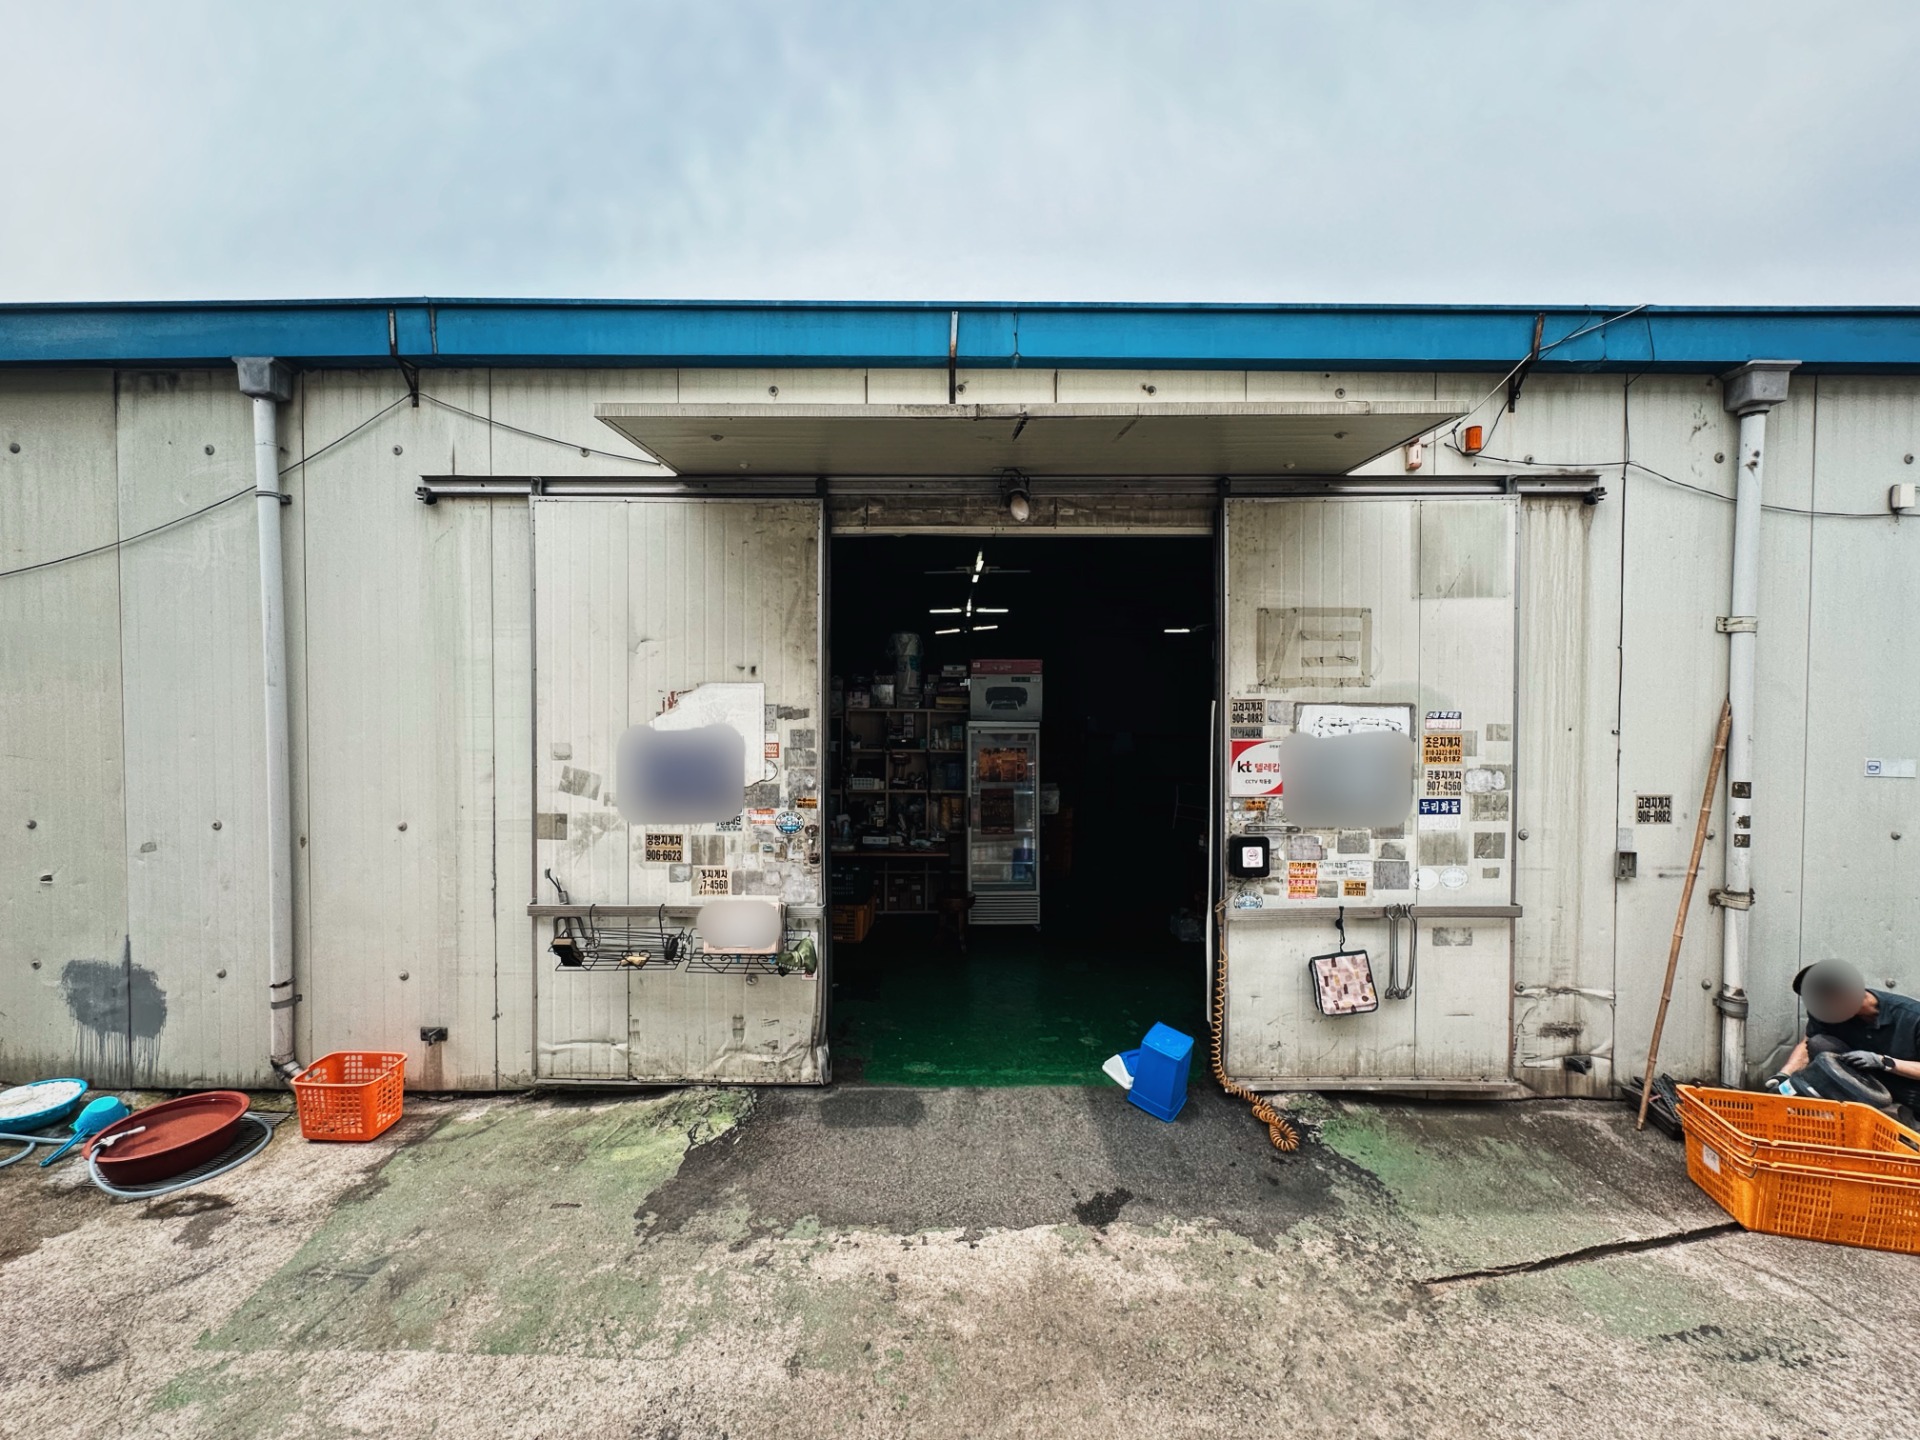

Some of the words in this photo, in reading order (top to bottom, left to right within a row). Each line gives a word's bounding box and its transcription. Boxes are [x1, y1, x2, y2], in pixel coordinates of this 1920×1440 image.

[1425, 736, 1461, 748] 조은지게차
[1237, 761, 1252, 773] kt
[1427, 770, 1462, 780] 극동지게차
[1427, 781, 1462, 791] 907-4560
[1421, 800, 1460, 814] 두리화물
[1638, 810, 1671, 822] 906-0882
[646, 849, 682, 861] 906-6623
